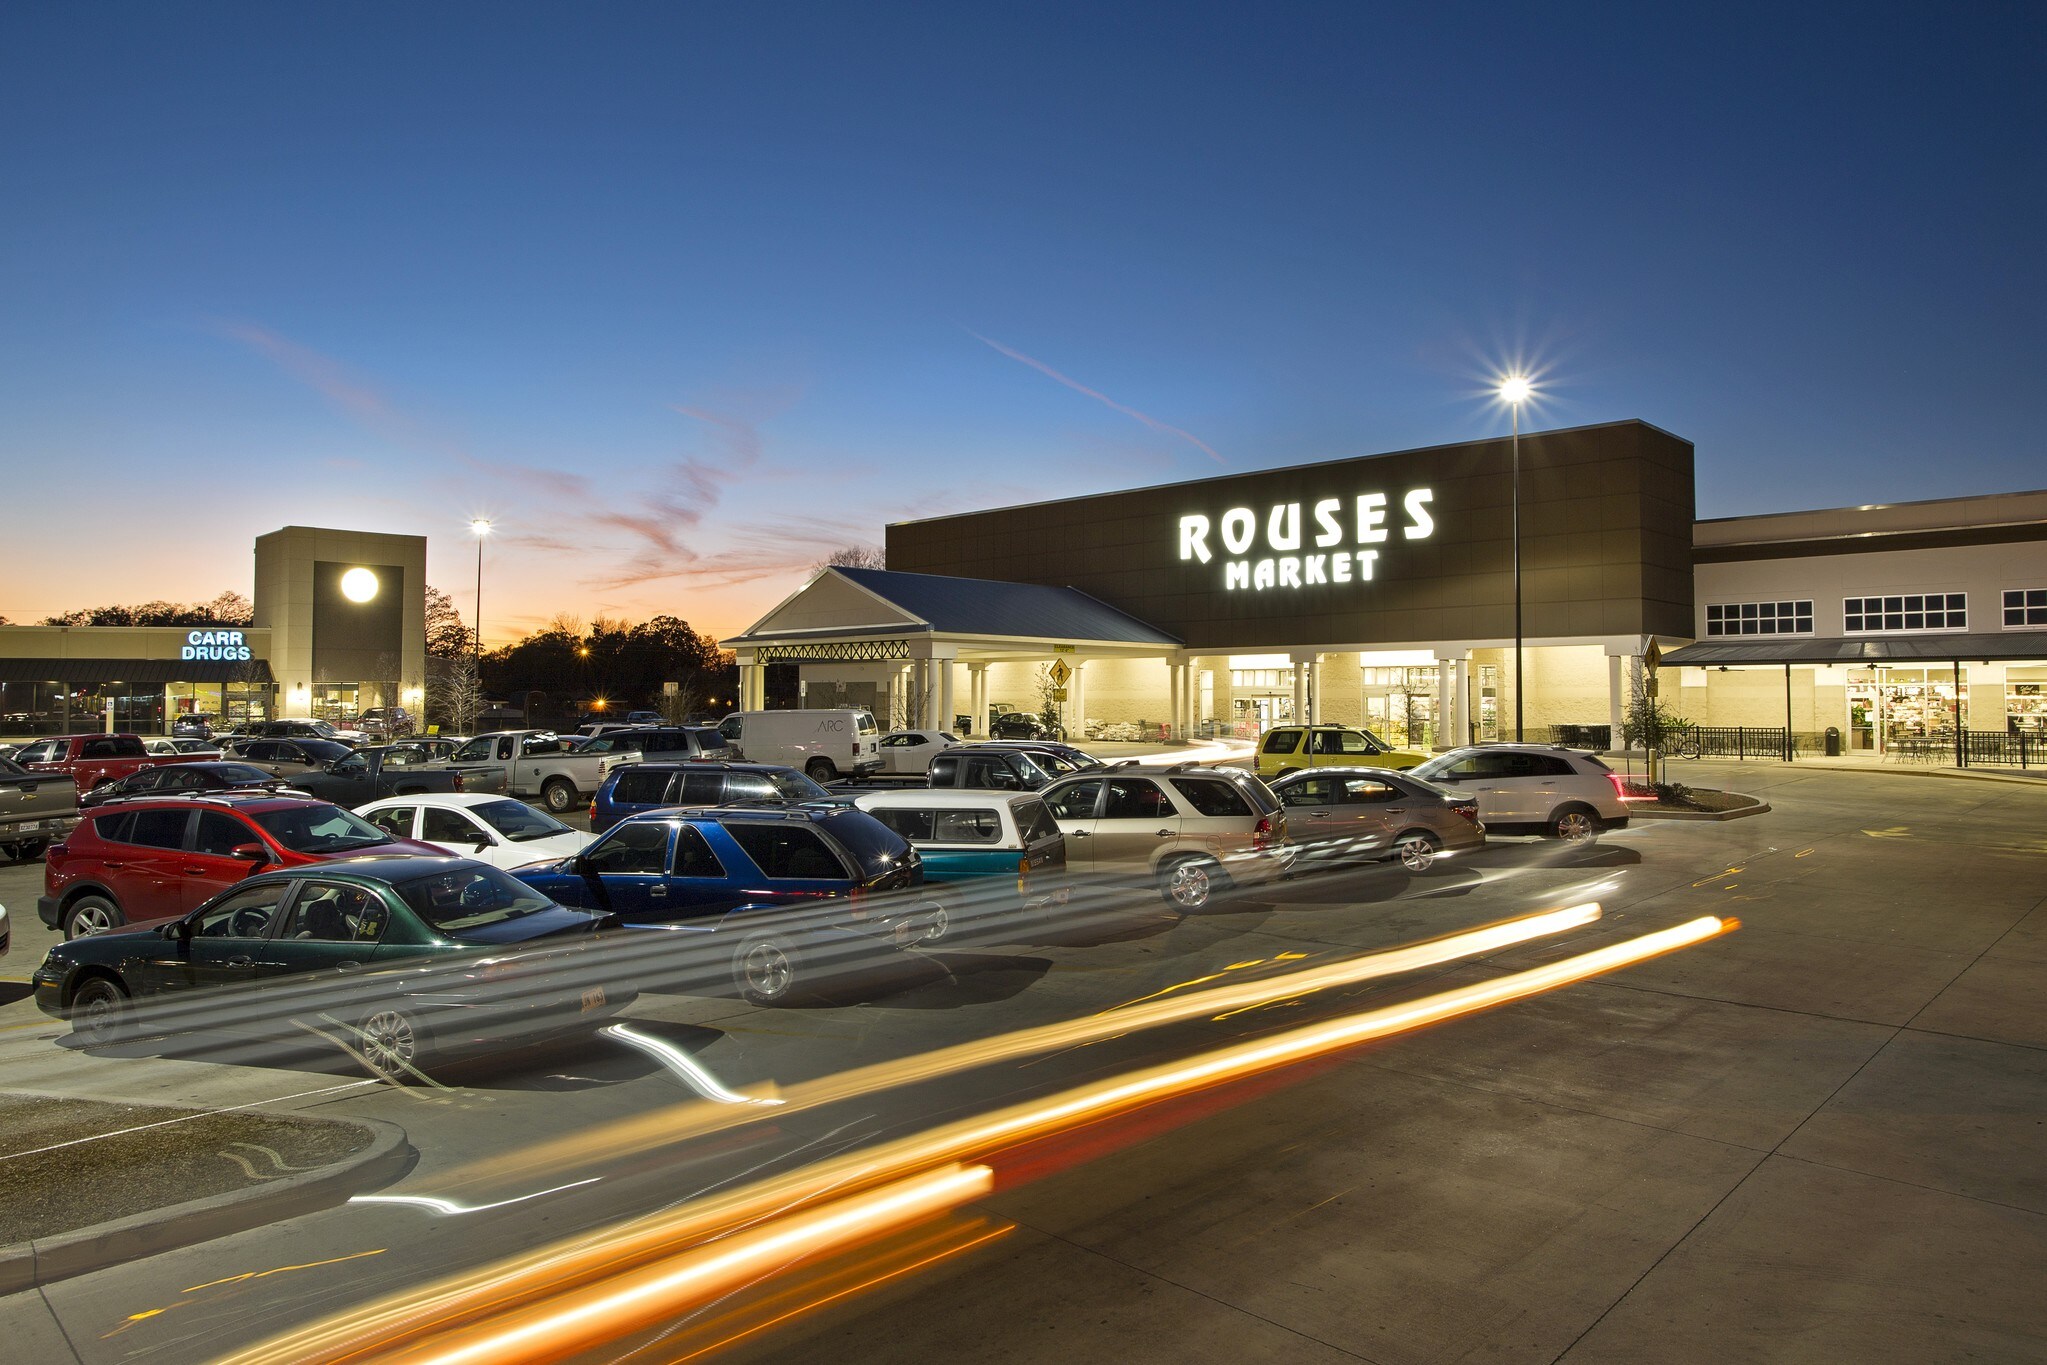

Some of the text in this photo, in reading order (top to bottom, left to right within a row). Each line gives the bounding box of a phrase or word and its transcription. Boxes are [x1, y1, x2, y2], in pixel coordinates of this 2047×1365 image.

[1178, 487, 1435, 565] ROUSES
[1225, 549, 1379, 591] MARKET
[188, 630, 243, 646] CARR
[181, 646, 251, 661] DRUGS
[817, 719, 844, 733] ARC
